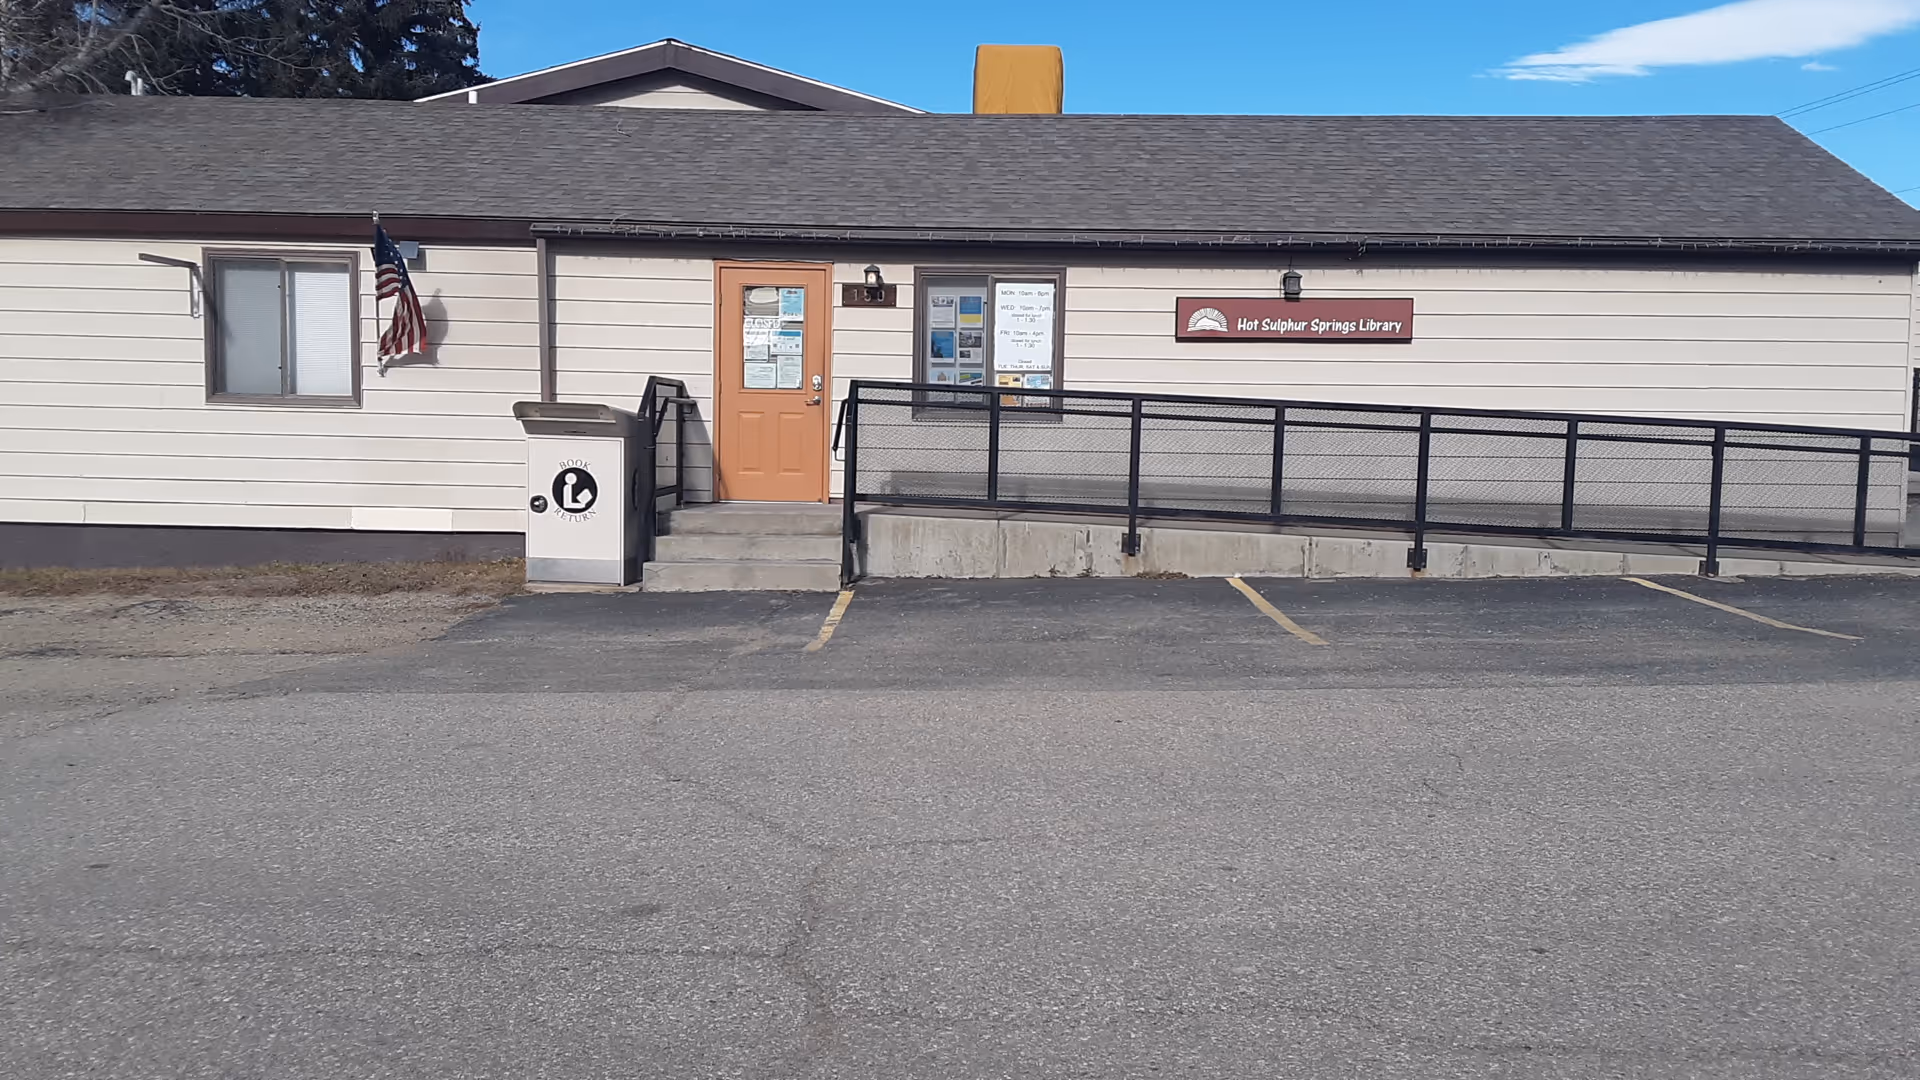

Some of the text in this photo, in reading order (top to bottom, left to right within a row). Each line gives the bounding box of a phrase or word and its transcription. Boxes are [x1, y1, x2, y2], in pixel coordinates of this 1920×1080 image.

[853, 288, 885, 302] 150
[1237, 318, 1403, 335] Hot Sulphur Springs Library
[559, 459, 591, 470] BOOK
[554, 507, 597, 523] RETURN
